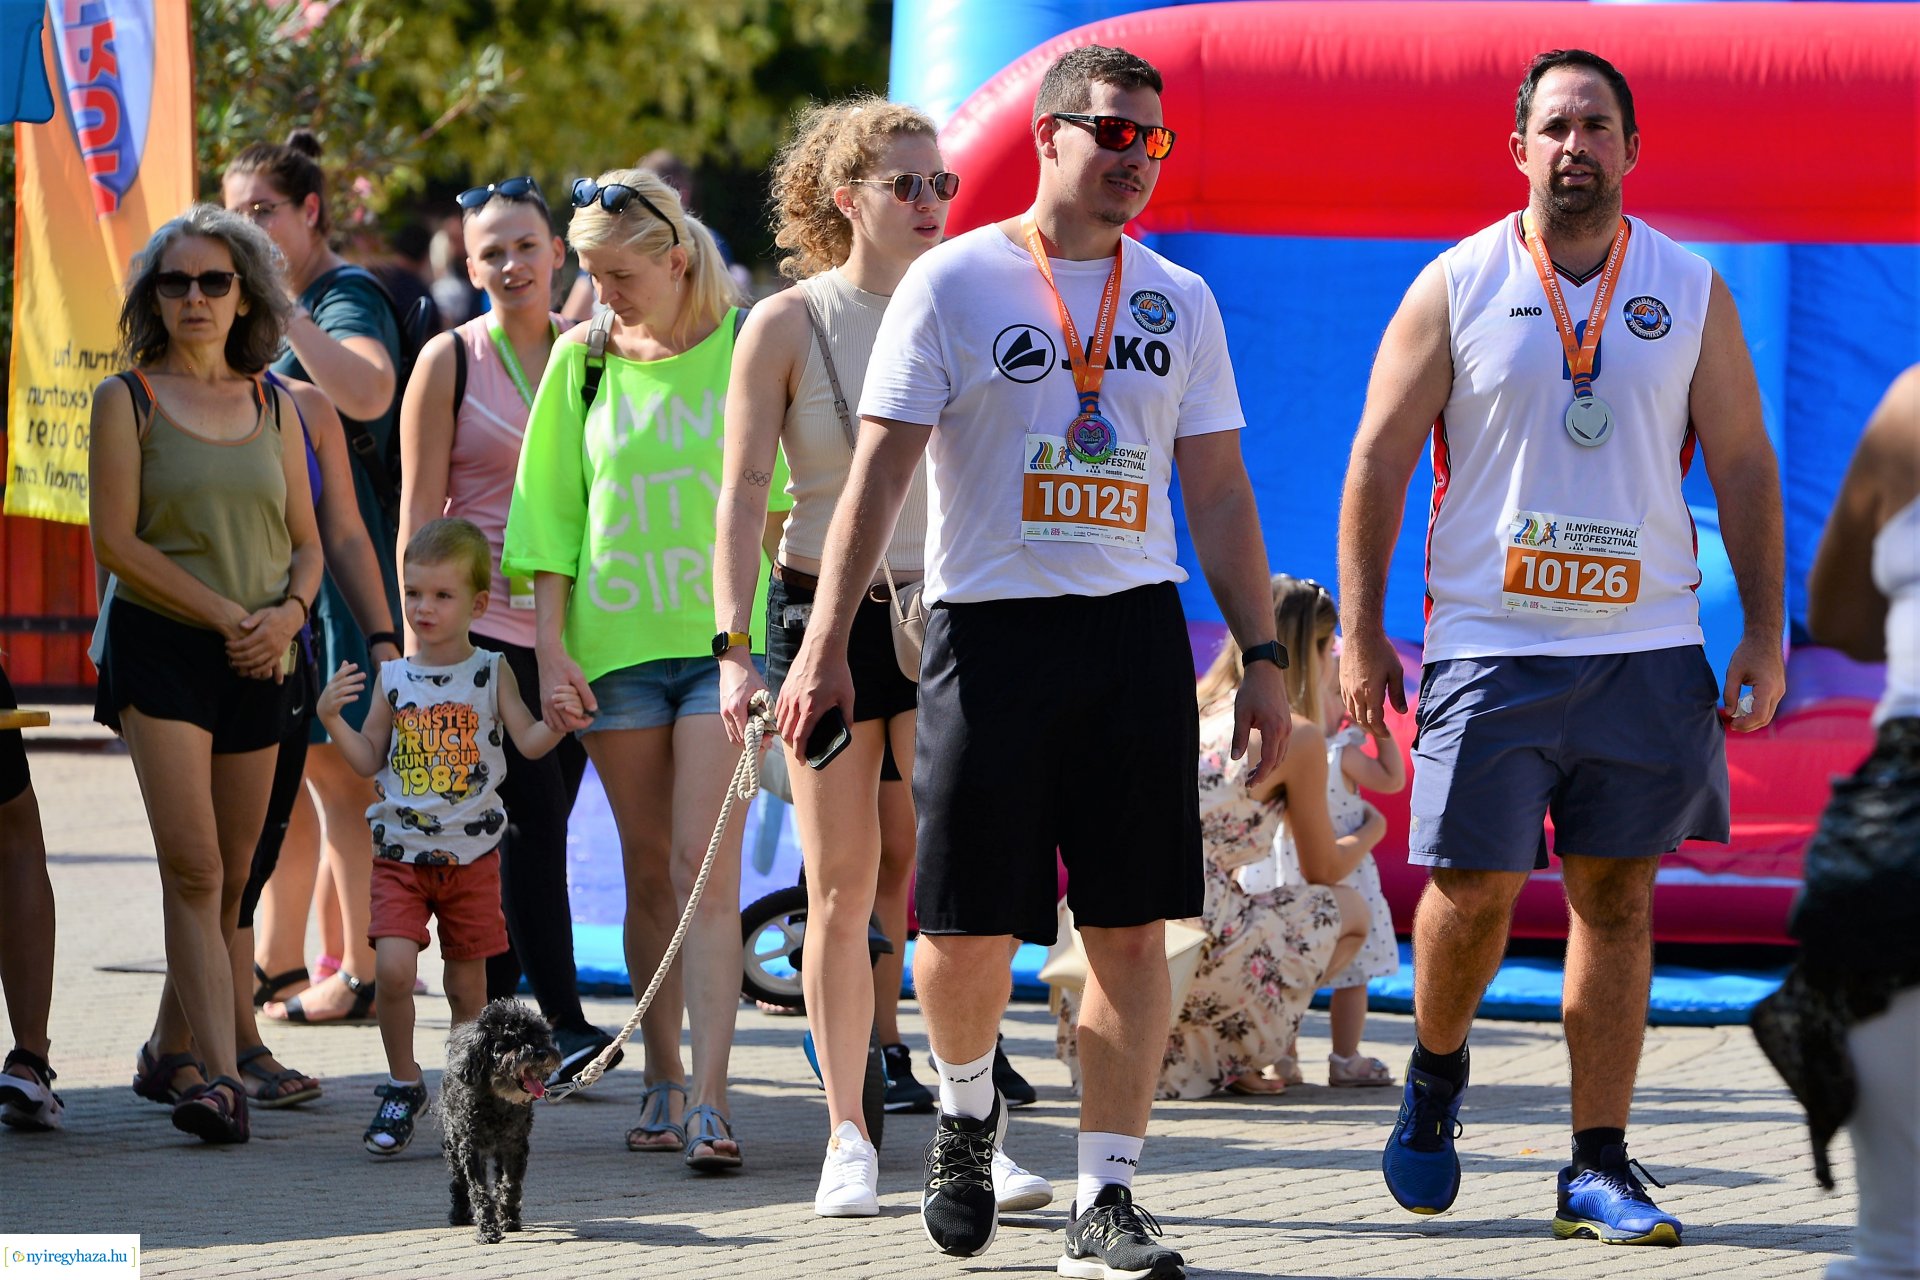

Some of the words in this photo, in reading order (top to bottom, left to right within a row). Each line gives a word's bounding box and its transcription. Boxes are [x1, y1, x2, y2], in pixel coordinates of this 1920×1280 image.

[1604, 229, 1625, 281] FUTÓFESZTIVÁL
[1509, 306, 1542, 317] JAKO
[1039, 481, 1137, 524] 10125
[1563, 533, 1638, 548] FUTÓFESZTIVÁL
[1566, 522, 1637, 539] II.NYÍREGYHÁZI
[588, 544, 716, 613] GIR
[1521, 555, 1628, 598] 10126
[393, 711, 479, 731] MONSTER
[398, 727, 478, 755] TRUCK
[392, 752, 435, 769] STUNT
[437, 750, 480, 766] TOUR
[399, 764, 469, 796] 1982
[948, 1067, 989, 1083] JAKO
